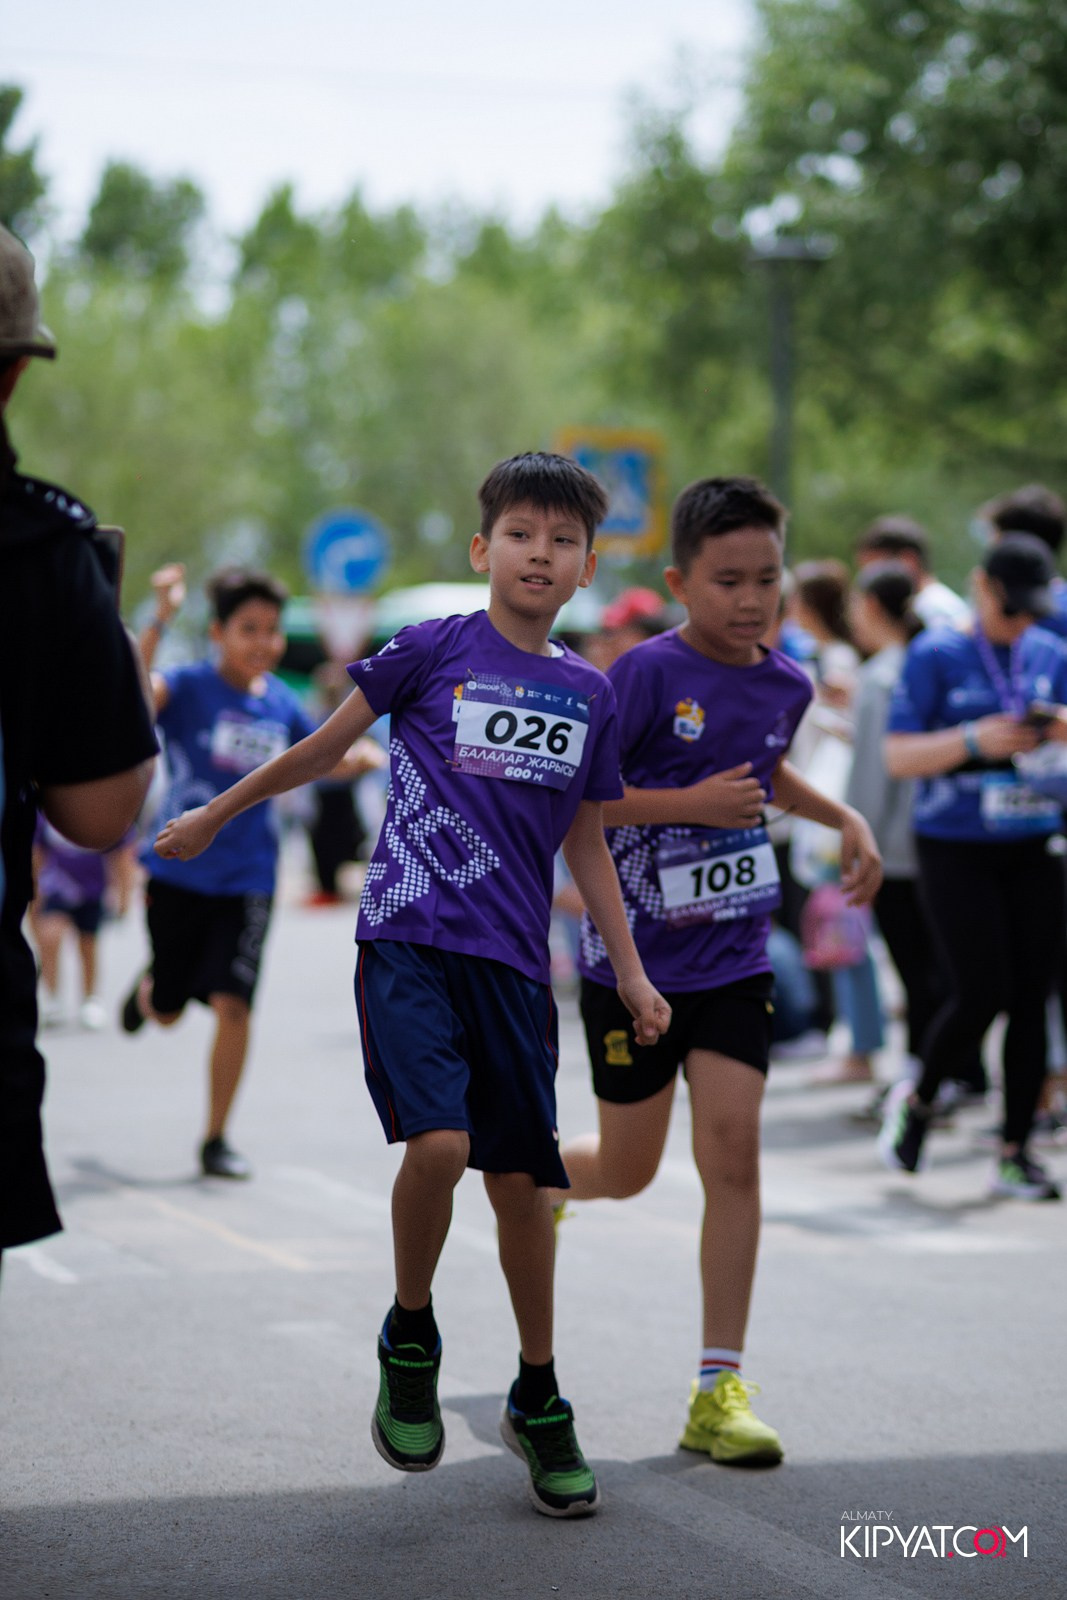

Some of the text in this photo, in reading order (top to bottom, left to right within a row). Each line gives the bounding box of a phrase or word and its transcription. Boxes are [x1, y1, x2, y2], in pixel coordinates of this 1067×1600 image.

[477, 683, 500, 691] GROUP
[485, 710, 573, 755] 026
[458, 746, 577, 778] БАЛАЛАР ЖАРЫСЫ
[504, 766, 532, 779] 600
[690, 855, 756, 898] 108
